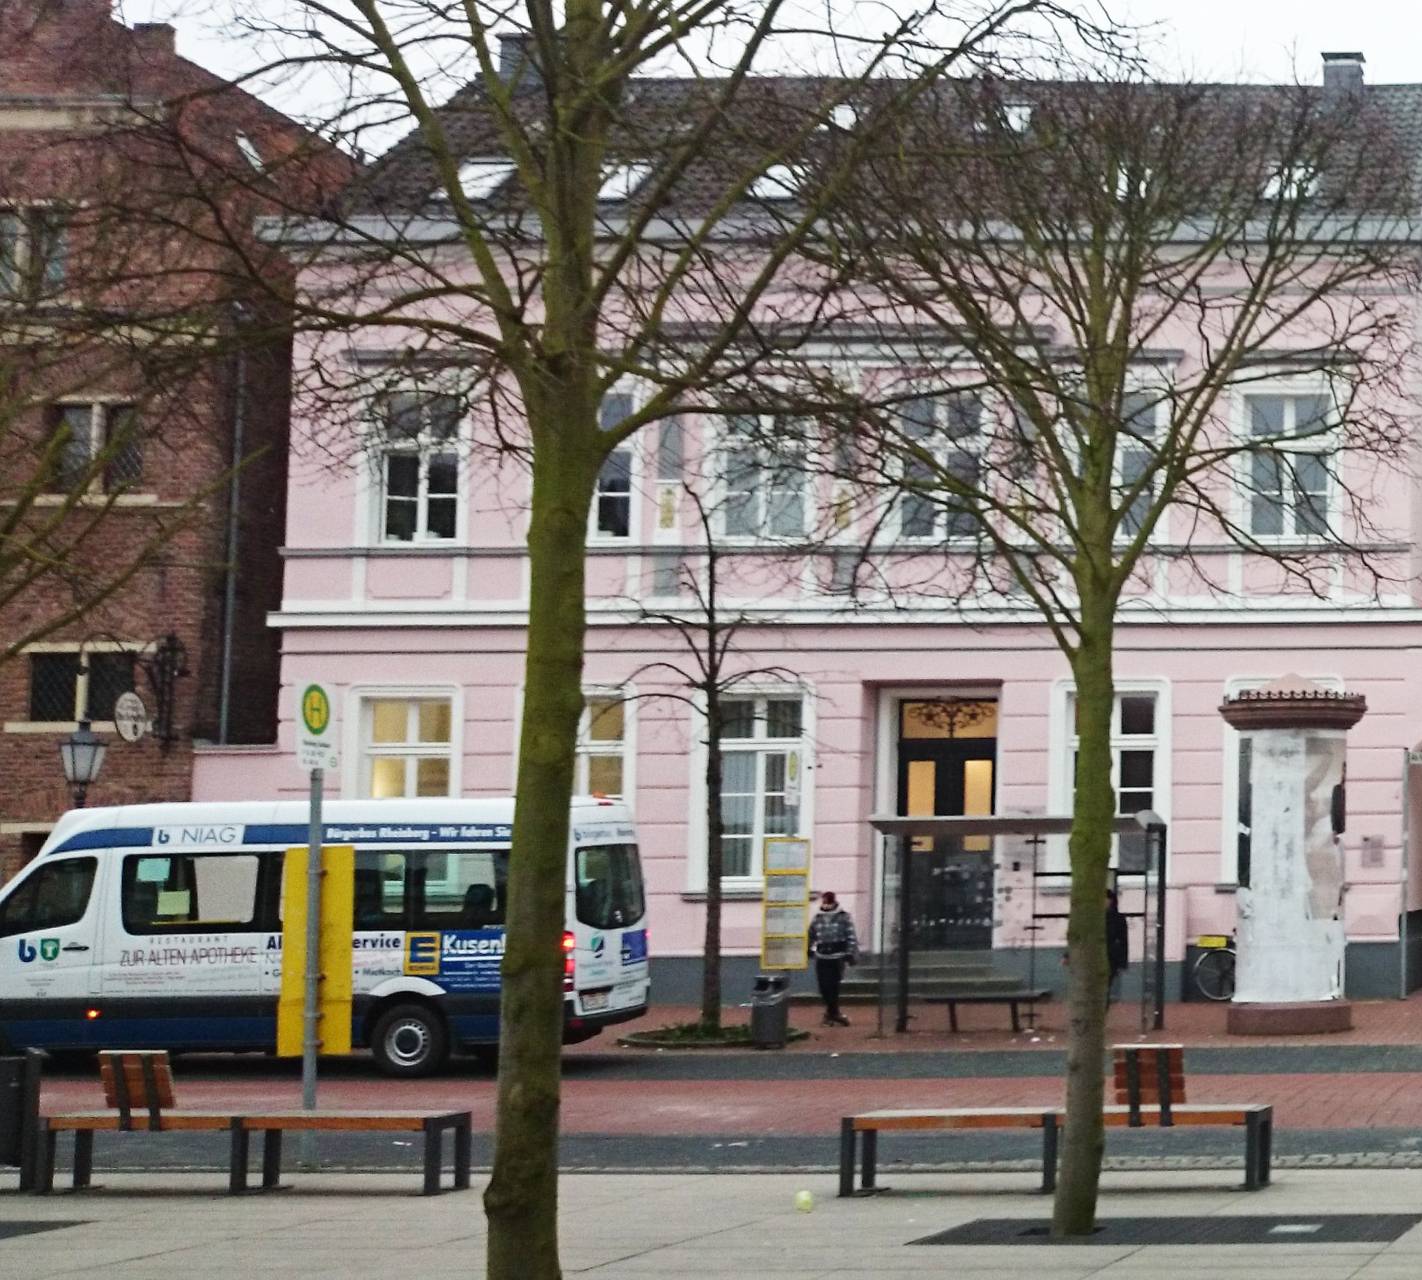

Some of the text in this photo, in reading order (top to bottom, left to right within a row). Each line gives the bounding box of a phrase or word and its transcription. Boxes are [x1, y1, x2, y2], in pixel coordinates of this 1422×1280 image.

[182, 826, 236, 843] NIAG
[438, 826, 459, 837] Wir
[352, 933, 401, 949] ervice
[120, 949, 145, 967] ZUR
[147, 948, 186, 966] ALTEN
[191, 946, 257, 965] APOTHEKE
